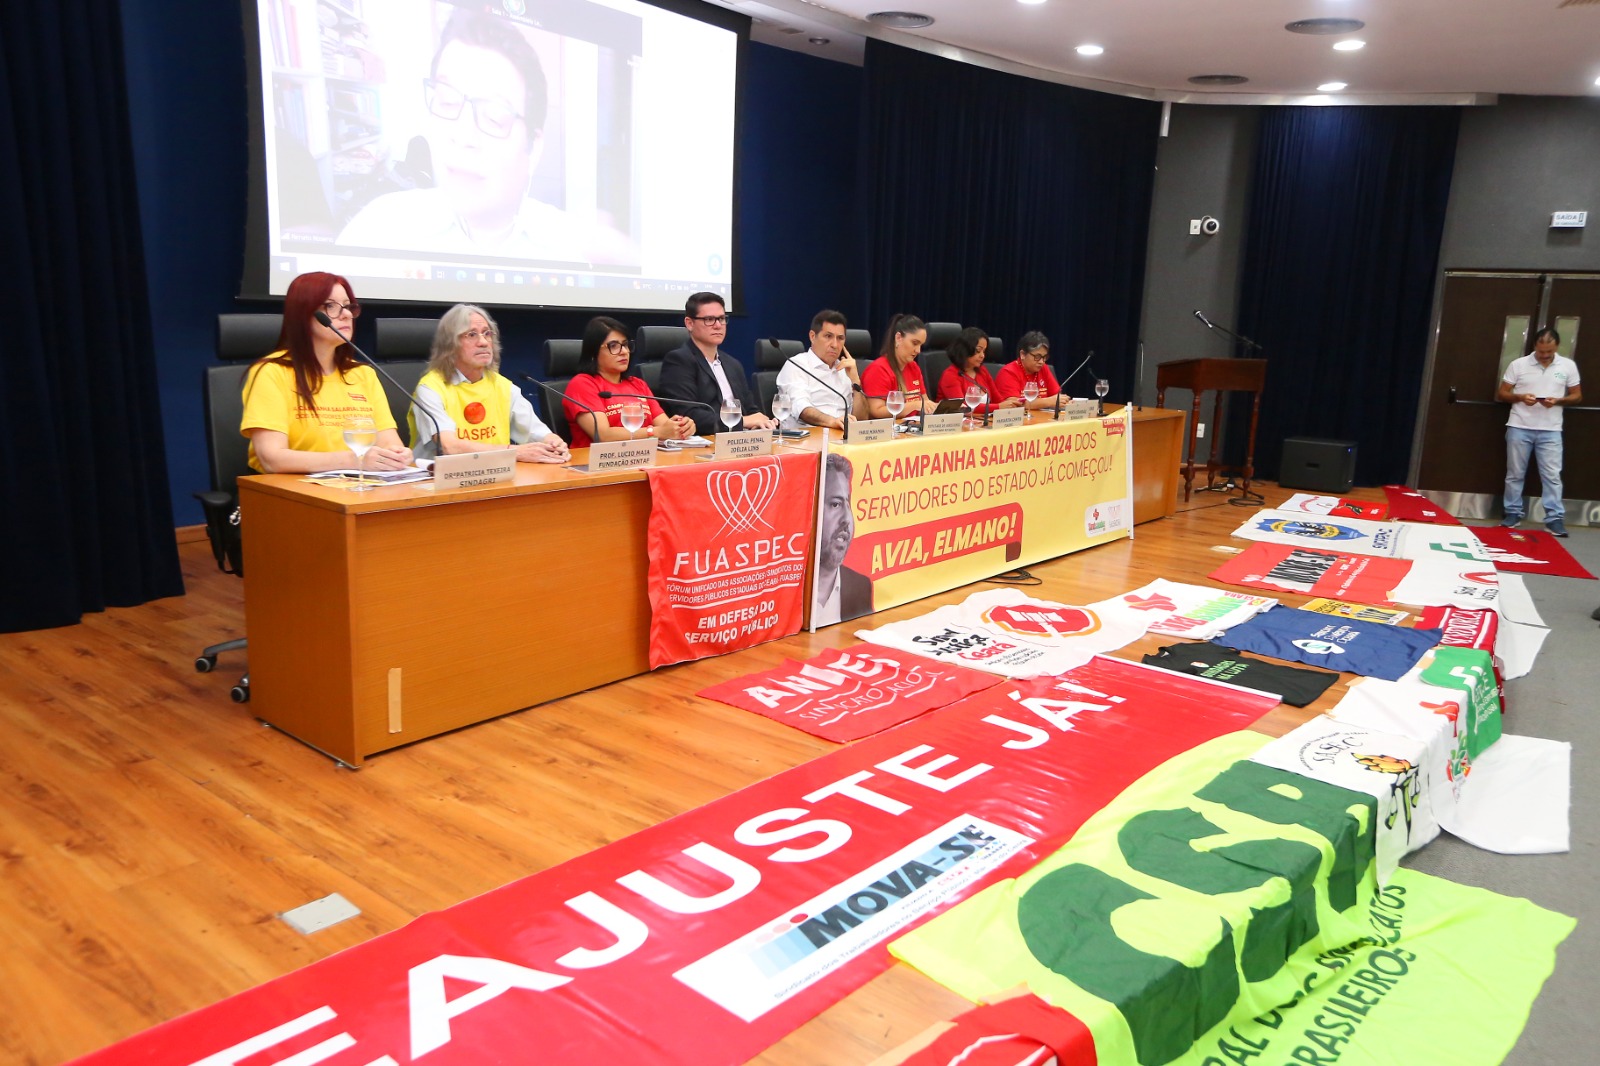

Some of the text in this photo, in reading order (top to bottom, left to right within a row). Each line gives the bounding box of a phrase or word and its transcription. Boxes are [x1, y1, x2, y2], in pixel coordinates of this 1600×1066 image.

[598, 457, 650, 469] FUNDAÇÃO SINTAF
[635, 449, 651, 457] MAIA
[860, 431, 1097, 486] A CAMPANHA SALARIAL 2024 DOS
[459, 477, 497, 489] SINDAGRI
[856, 454, 1113, 522] SERVIDORES DO ESTADO JÁ COMEÇOU!
[673, 532, 804, 576] FUASPEC
[870, 512, 1019, 575] AVIA, ELMANO!
[667, 582, 691, 595] FÓRUM
[691, 581, 718, 595] UNIFICADO
[717, 579, 729, 589] DAS
[698, 615, 717, 629] EM
[759, 600, 775, 614] DO
[684, 627, 738, 645] SERVIÇO
[957, 640, 1017, 661] Ceará
[799, 687, 884, 720] SINICATO
[981, 680, 1127, 749] JÁ!
[798, 824, 996, 949] MOVA-SE
[1283, 947, 1417, 1066] RASILEIROS
